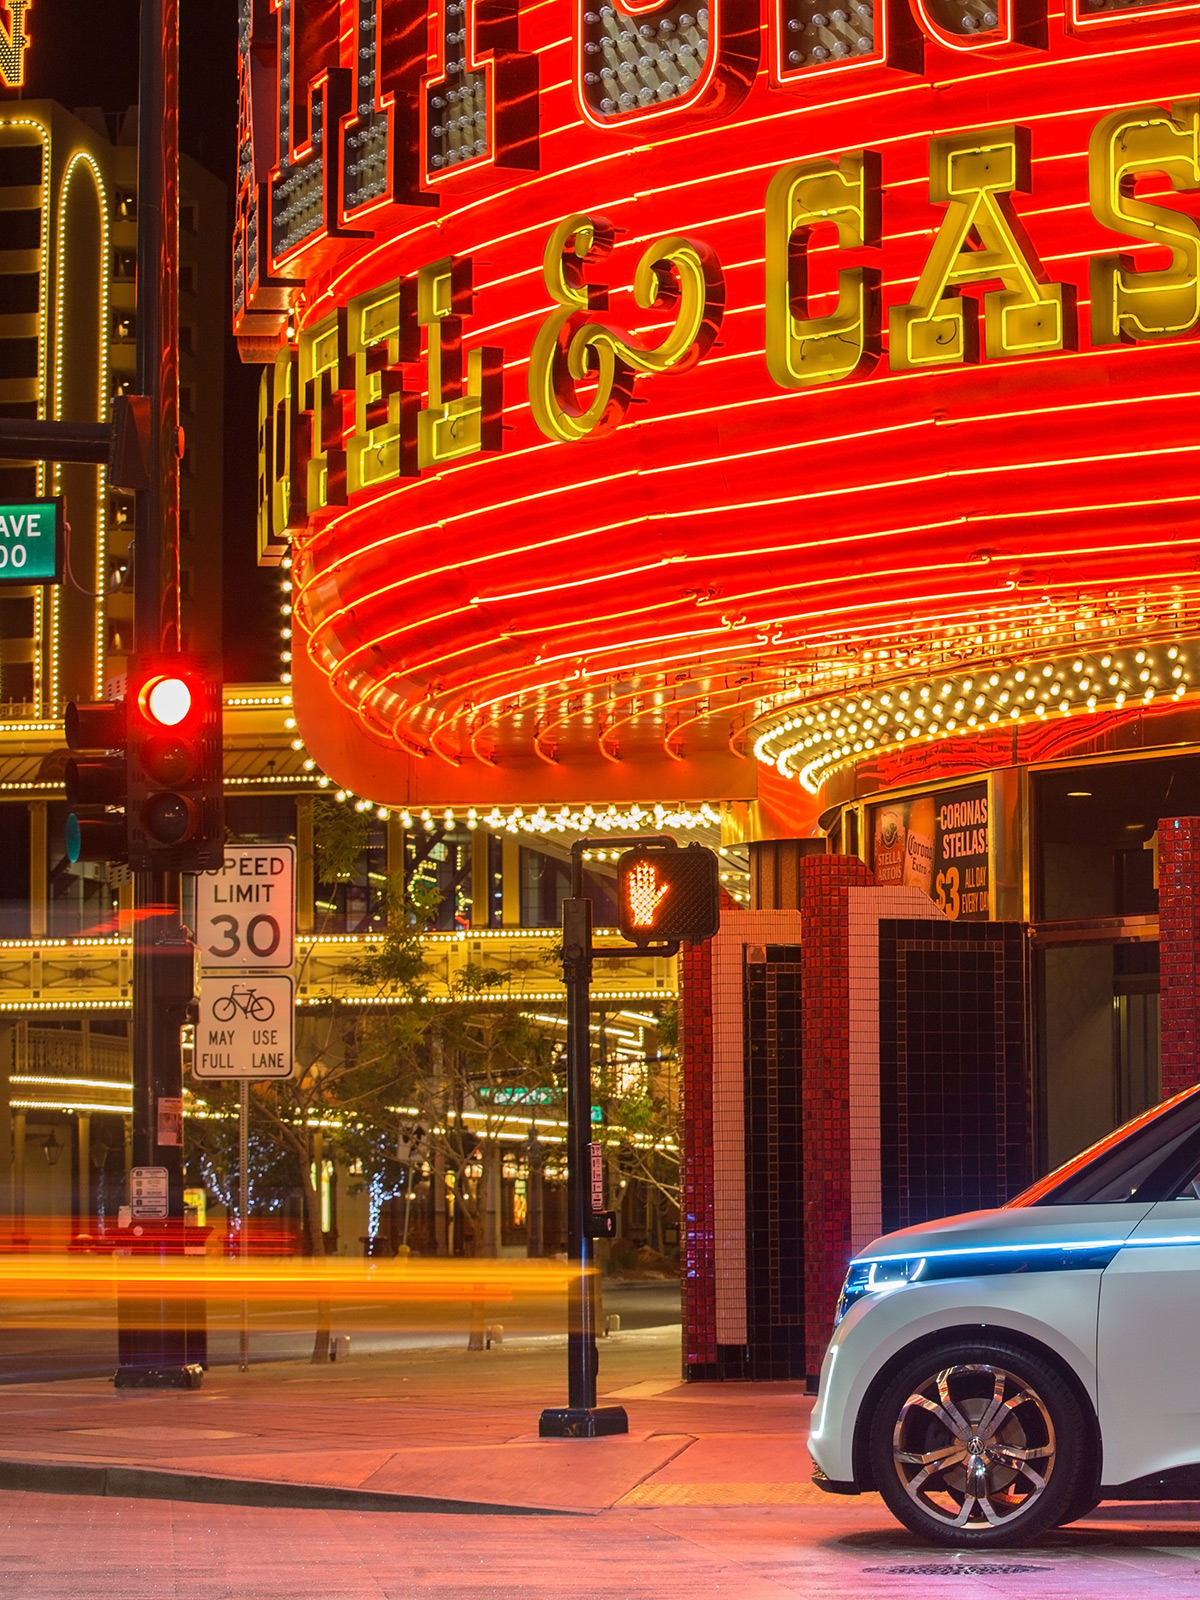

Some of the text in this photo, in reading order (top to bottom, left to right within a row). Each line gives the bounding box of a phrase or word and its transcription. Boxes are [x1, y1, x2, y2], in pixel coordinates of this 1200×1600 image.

[528, 212, 722, 443] &
[0, 514, 41, 537] AVE
[941, 798, 987, 830] CORONAS
[943, 828, 988, 859] STELLAS!
[214, 884, 275, 903] LIMIT
[936, 866, 960, 921] $3
[208, 913, 281, 957] 30
[209, 1030, 278, 1045] MAY USE
[202, 1053, 285, 1068] FULL LANE
